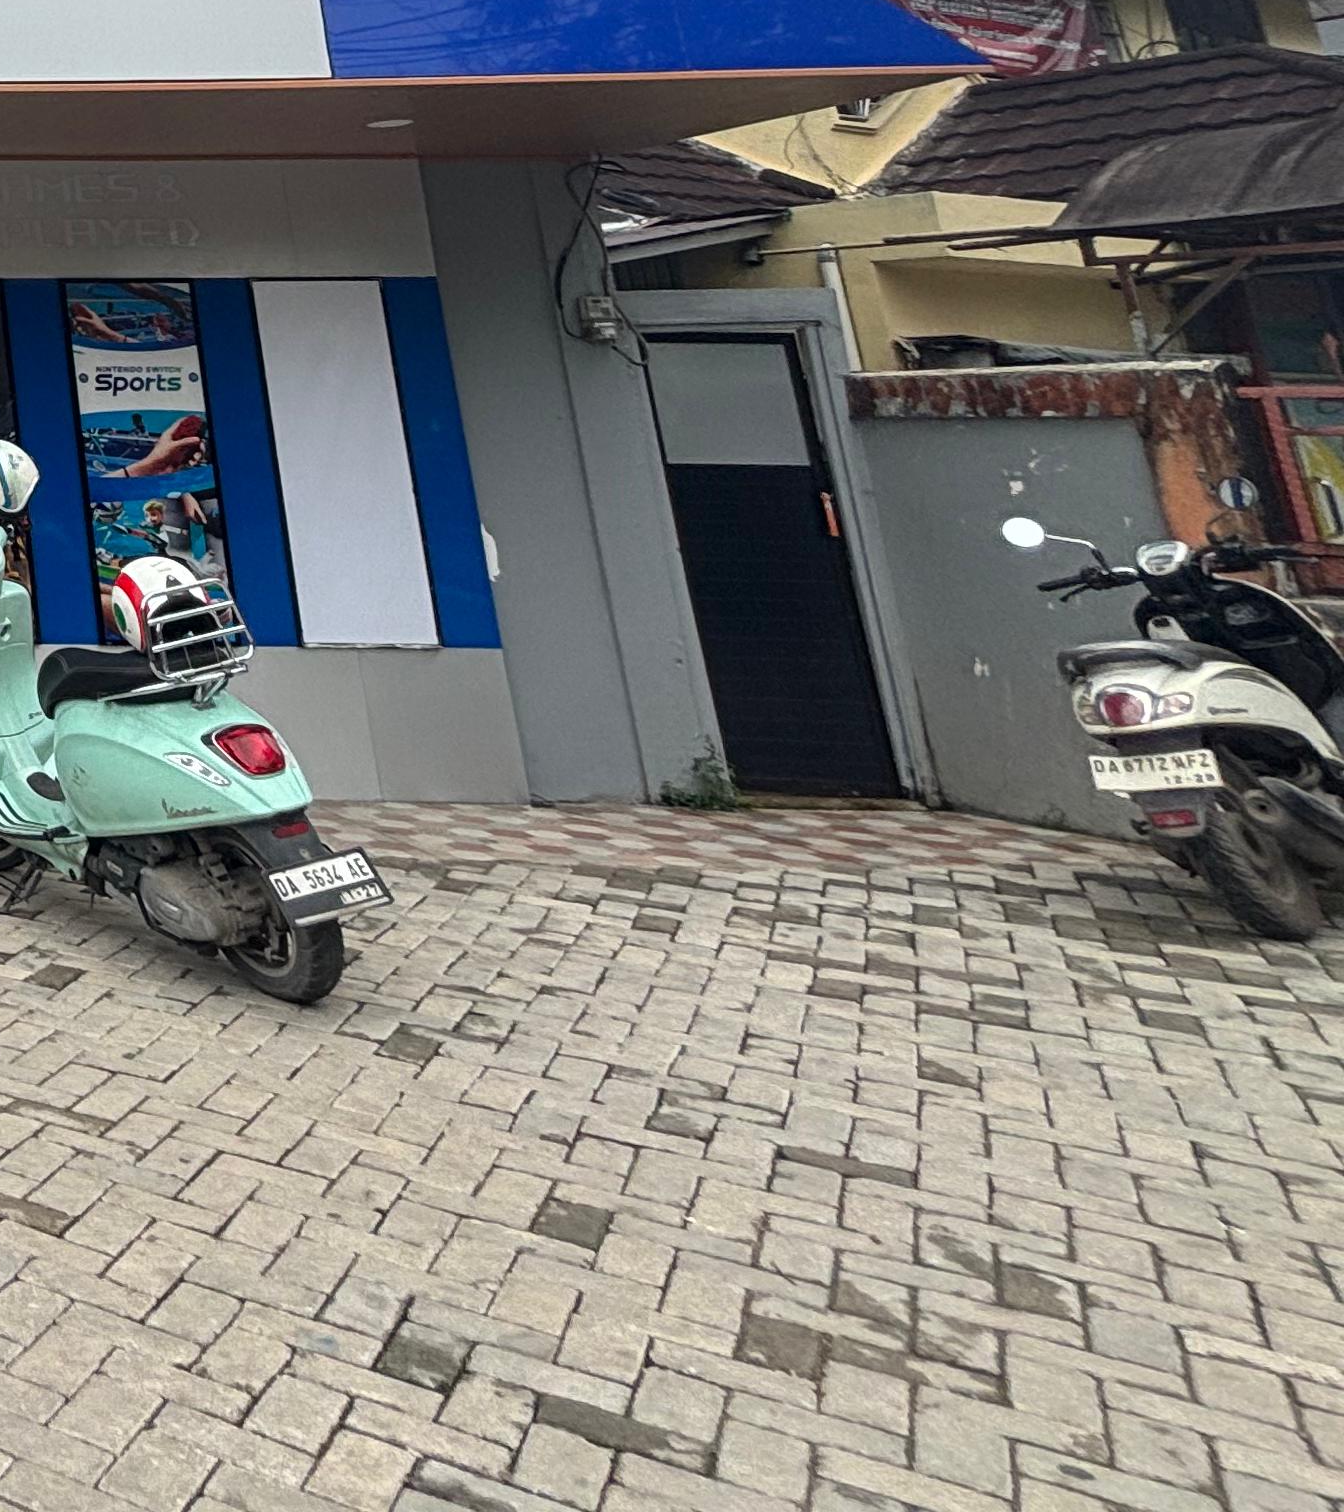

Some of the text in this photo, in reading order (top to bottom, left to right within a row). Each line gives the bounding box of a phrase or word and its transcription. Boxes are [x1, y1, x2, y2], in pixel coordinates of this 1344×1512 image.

[94, 373, 182, 396] Sports
[274, 857, 370, 898] DA 5634 AE
